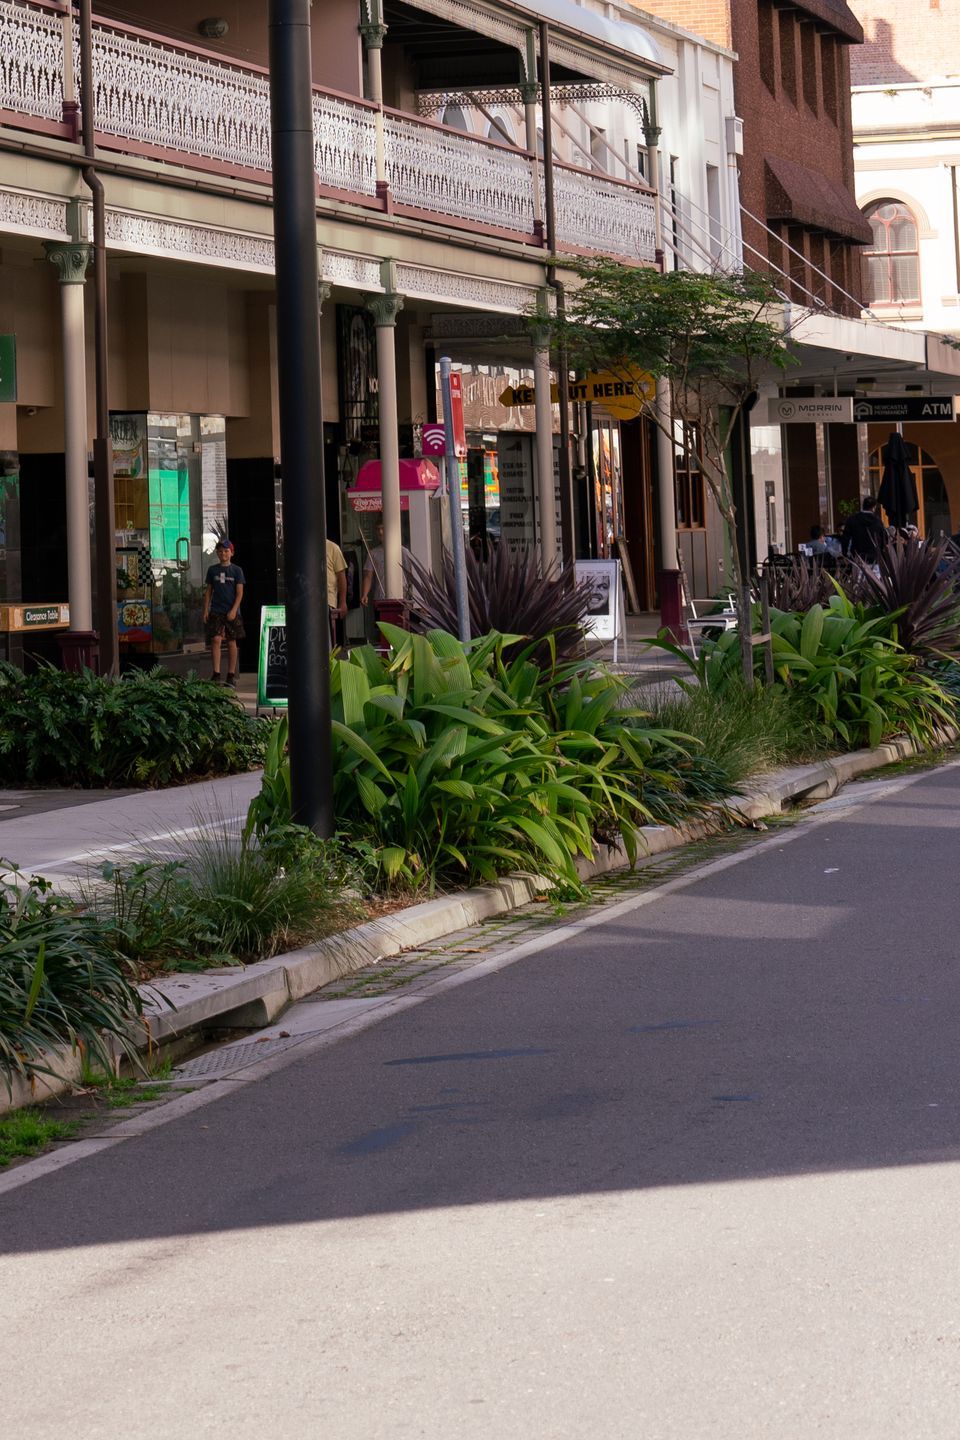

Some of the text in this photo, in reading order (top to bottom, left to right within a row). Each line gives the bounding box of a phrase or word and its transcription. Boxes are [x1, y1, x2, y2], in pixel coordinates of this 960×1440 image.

[558, 385, 588, 400] UT
[593, 381, 634, 398] HERE
[798, 404, 842, 412] MORRIN
[921, 403, 952, 415] ATM
[26, 610, 58, 622] Clearance Table
